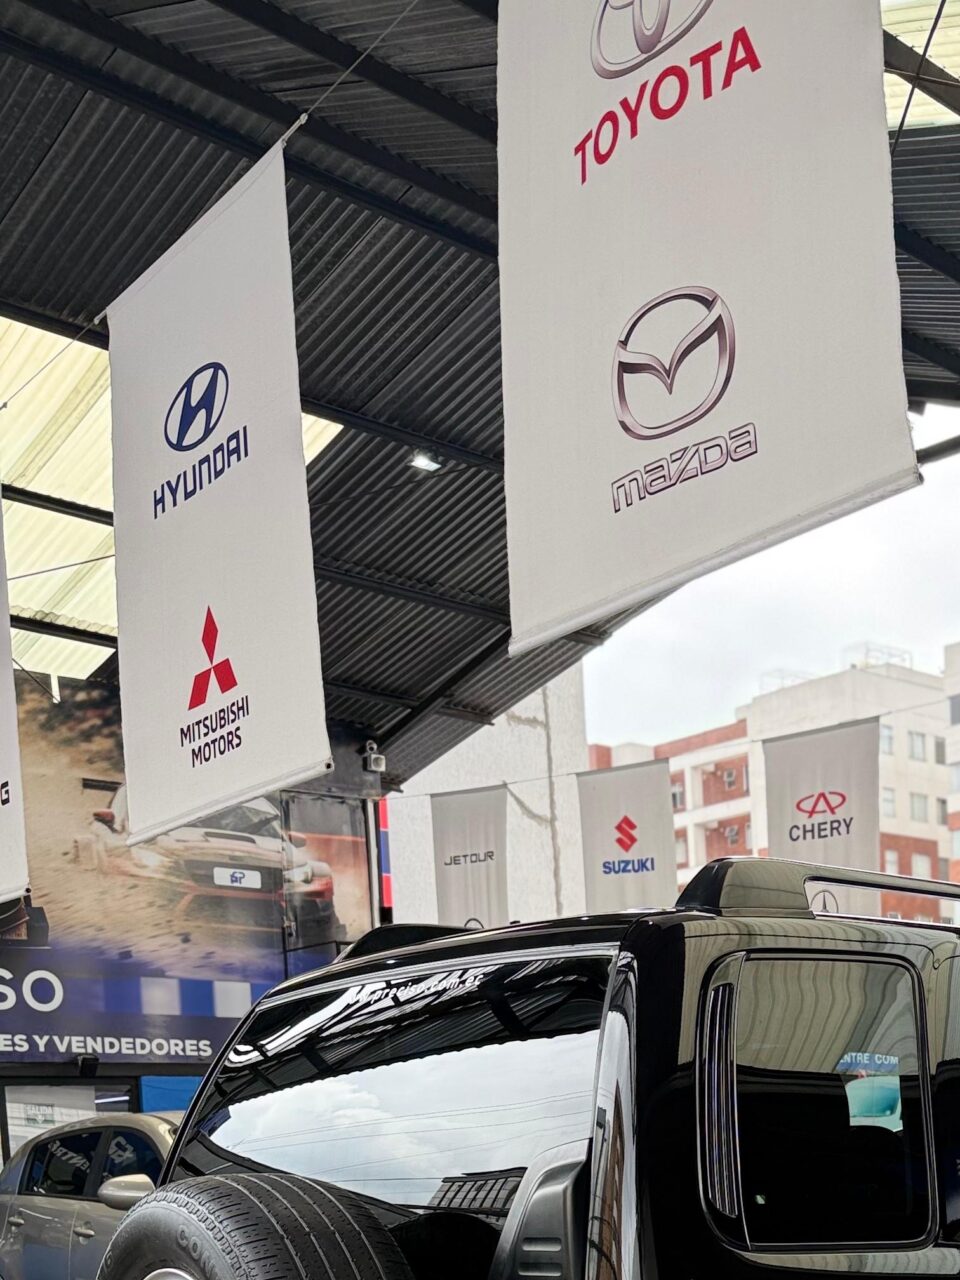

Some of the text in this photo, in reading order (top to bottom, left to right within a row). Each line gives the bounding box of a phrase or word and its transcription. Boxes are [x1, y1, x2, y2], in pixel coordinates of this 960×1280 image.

[573, 25, 762, 186] TOYOTA
[153, 425, 249, 520] HYUNDAI
[179, 694, 250, 748] MITSUBISHI
[191, 726, 243, 769] MOTORS
[788, 817, 854, 842] CHERY
[444, 850, 495, 866] JETOUR
[602, 857, 655, 875] SUZUKI
[32, 1034, 50, 1053] Y
[52, 1035, 213, 1057] VENDEDORES
